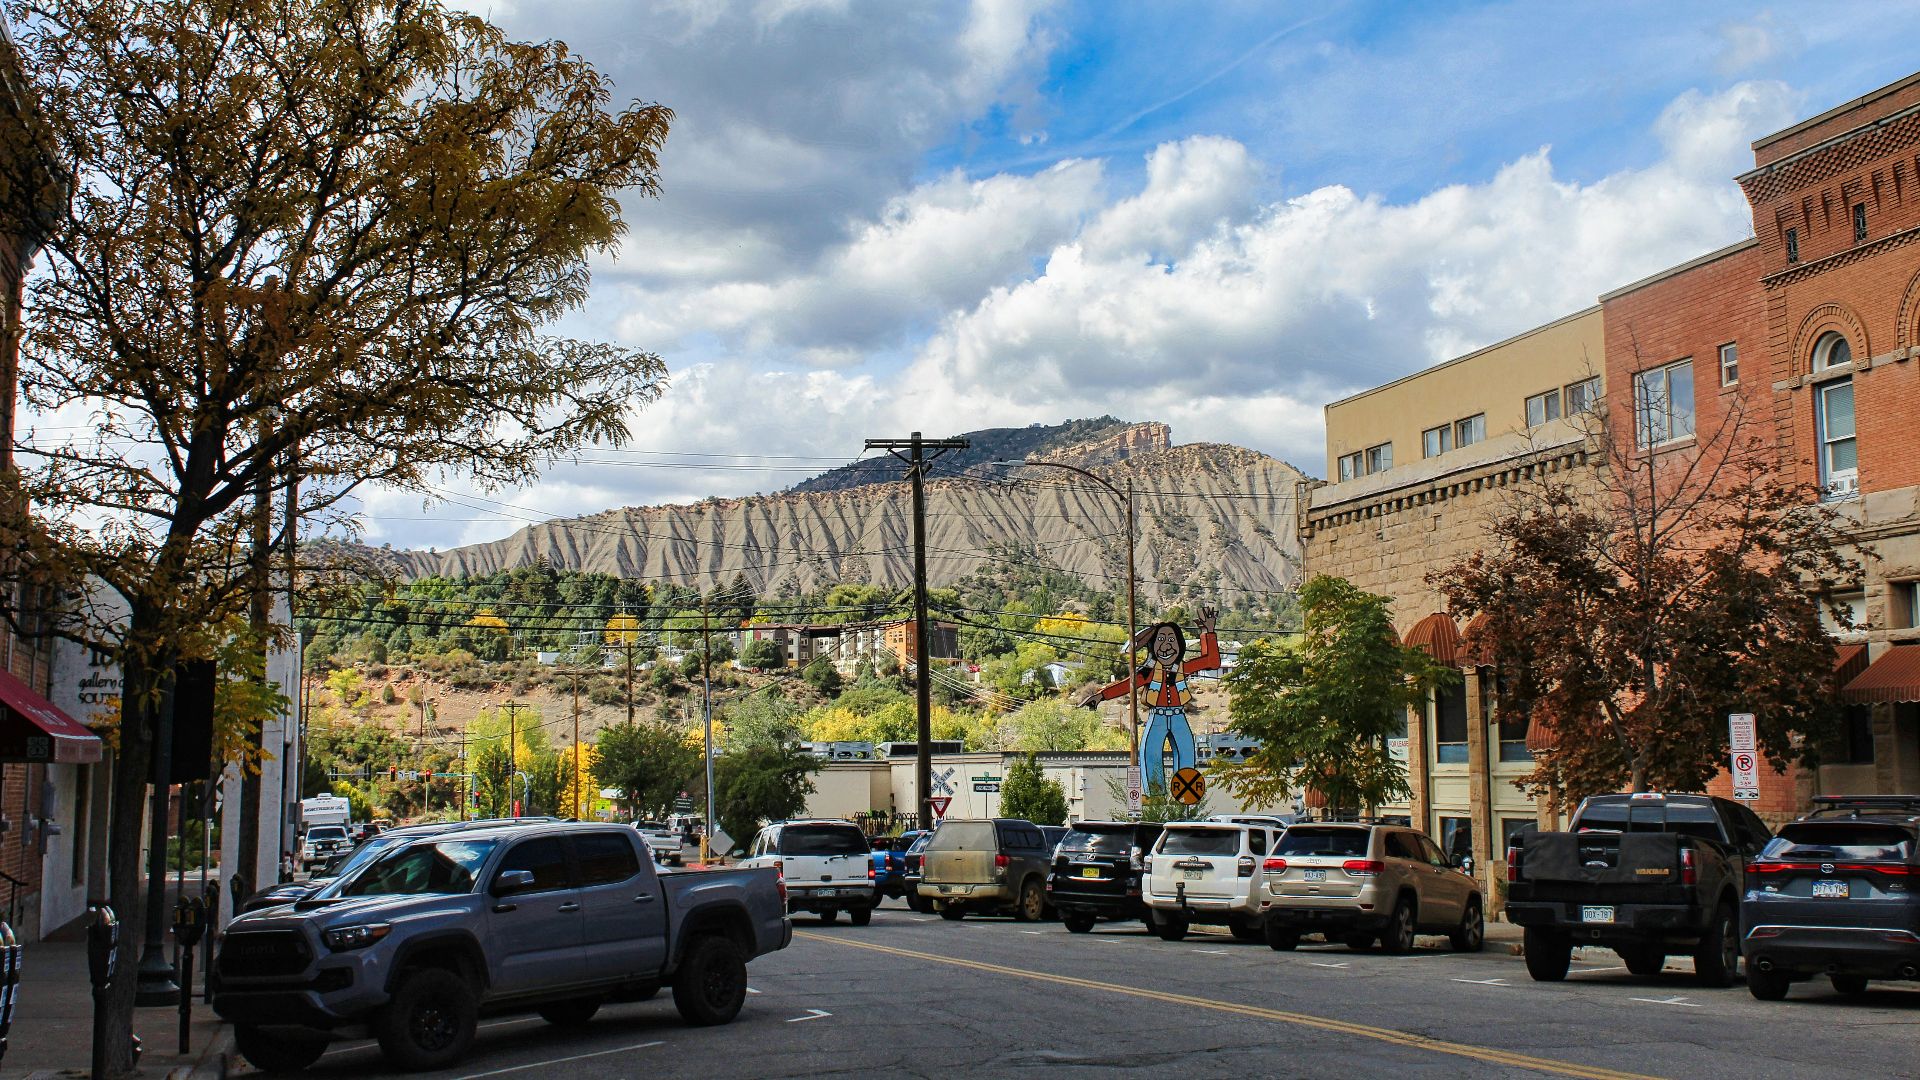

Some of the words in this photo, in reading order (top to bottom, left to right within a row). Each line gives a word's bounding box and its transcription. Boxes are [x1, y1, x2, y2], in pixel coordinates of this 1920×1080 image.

[79, 672, 117, 691] gallery
[1173, 782, 1180, 791] R
[1196, 782, 1203, 791] R
